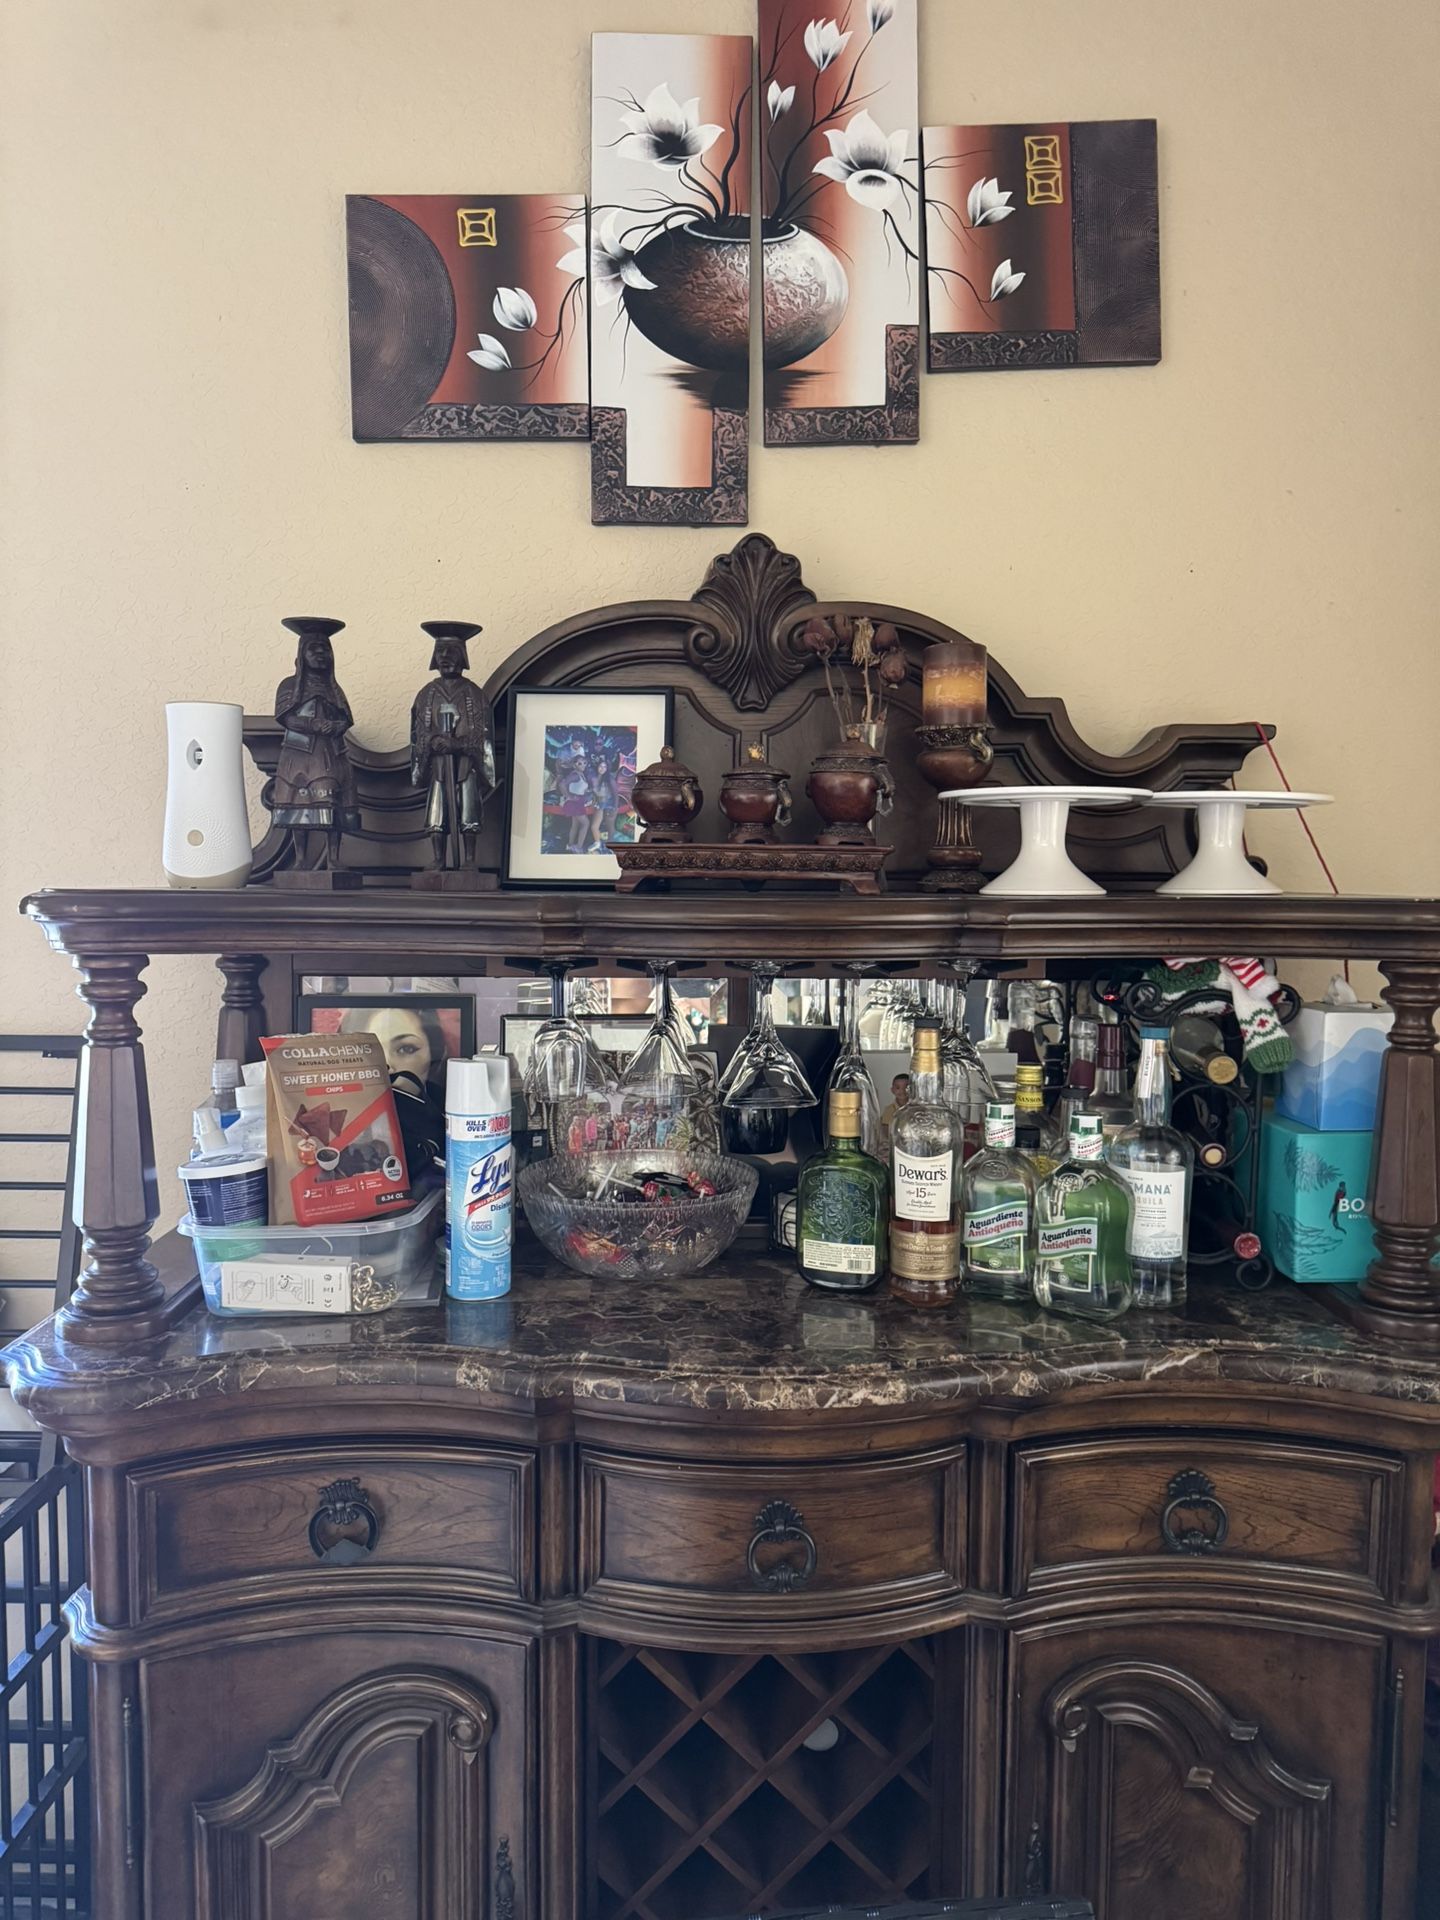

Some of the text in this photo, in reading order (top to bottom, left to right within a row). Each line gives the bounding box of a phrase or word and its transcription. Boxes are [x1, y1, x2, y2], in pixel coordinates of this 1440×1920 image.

[282, 1044, 373, 1060] COLLACHEWS
[283, 1069, 381, 1086] SWEET HONEY BBQ
[325, 1086, 344, 1094] CHIPS
[898, 1163, 947, 1181] Dewar's
[915, 1187, 927, 1198] 15
[1128, 1182, 1171, 1196] MANA
[969, 1210, 1024, 1229] Aguardiente
[967, 1218, 1024, 1238] Antioqueño
[1041, 1227, 1092, 1242] Aguardiente
[1040, 1235, 1093, 1251] Antioqueño
